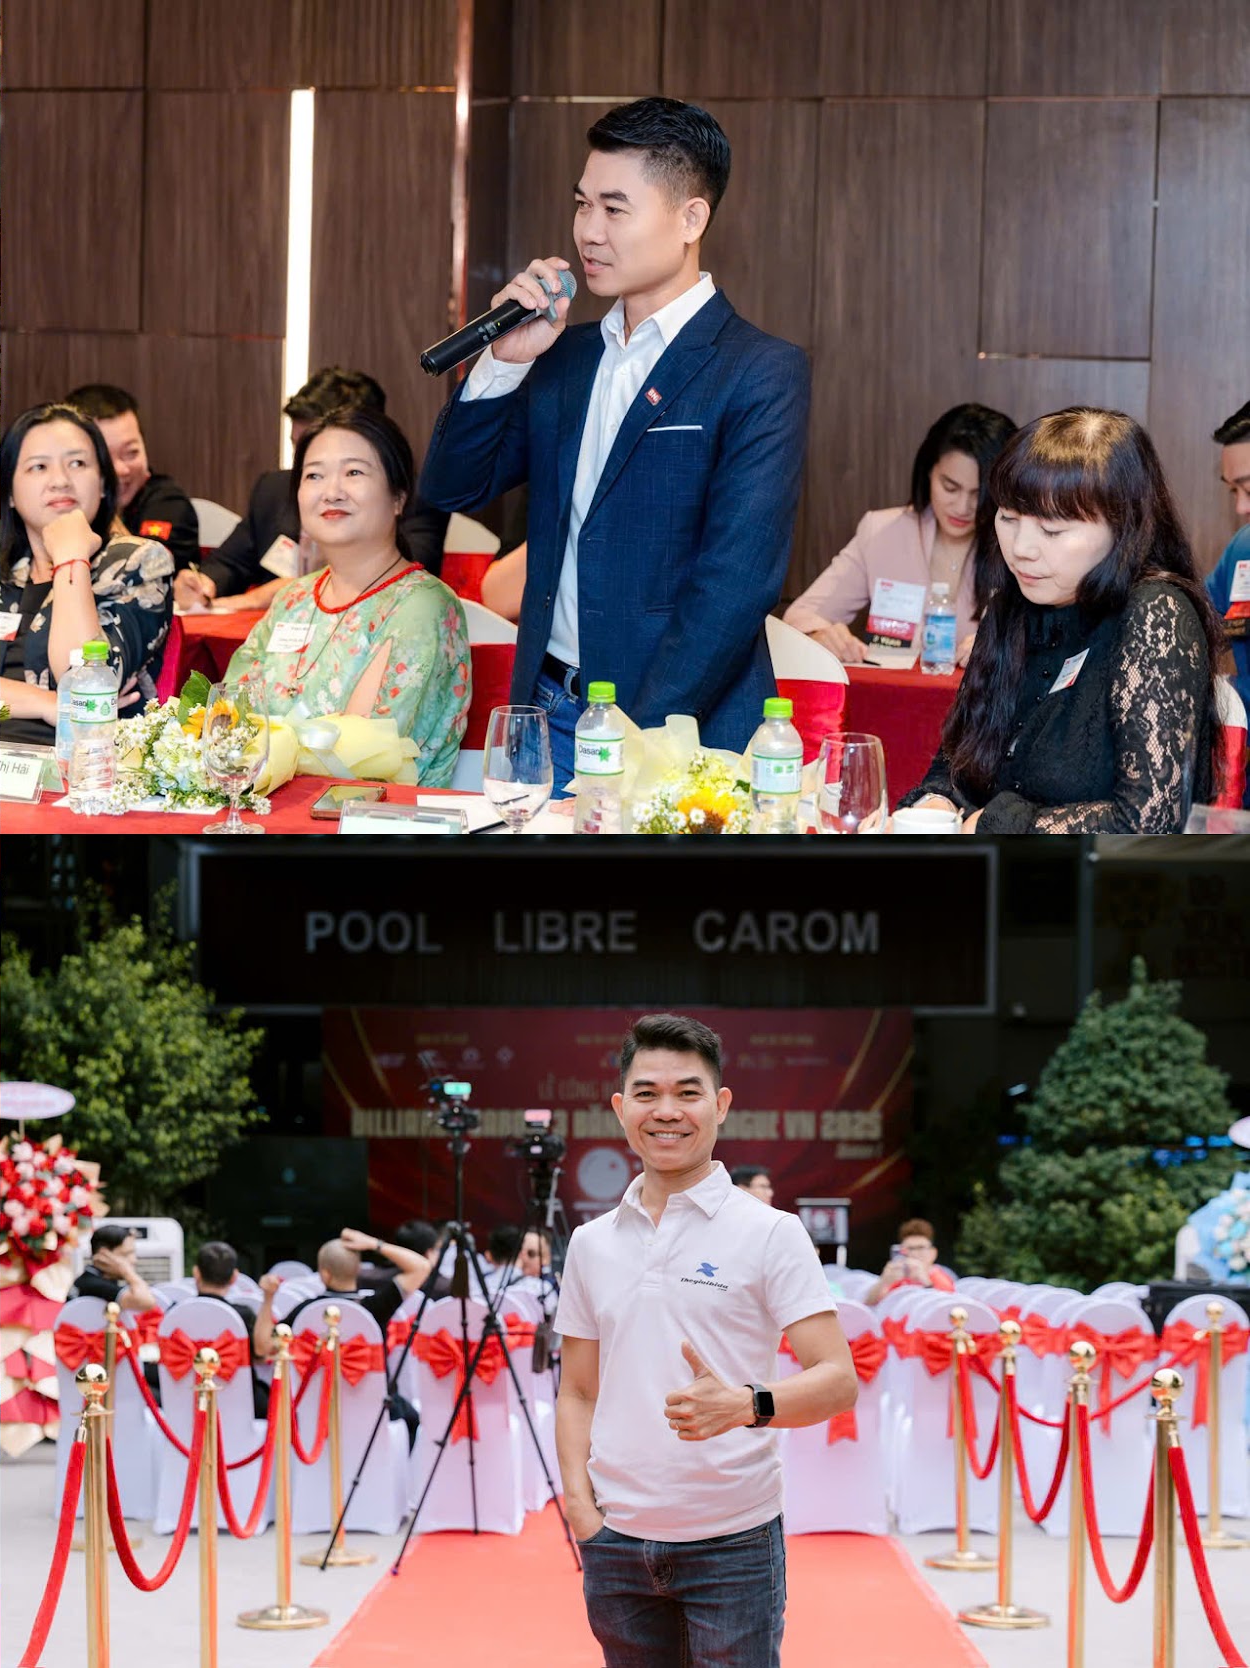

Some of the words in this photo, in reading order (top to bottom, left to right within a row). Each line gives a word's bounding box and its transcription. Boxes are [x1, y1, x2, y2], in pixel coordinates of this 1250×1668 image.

[12, 761, 30, 775] Hải
[305, 910, 442, 955] POOL
[494, 909, 637, 954] LIBRE
[693, 908, 882, 955] CAROM
